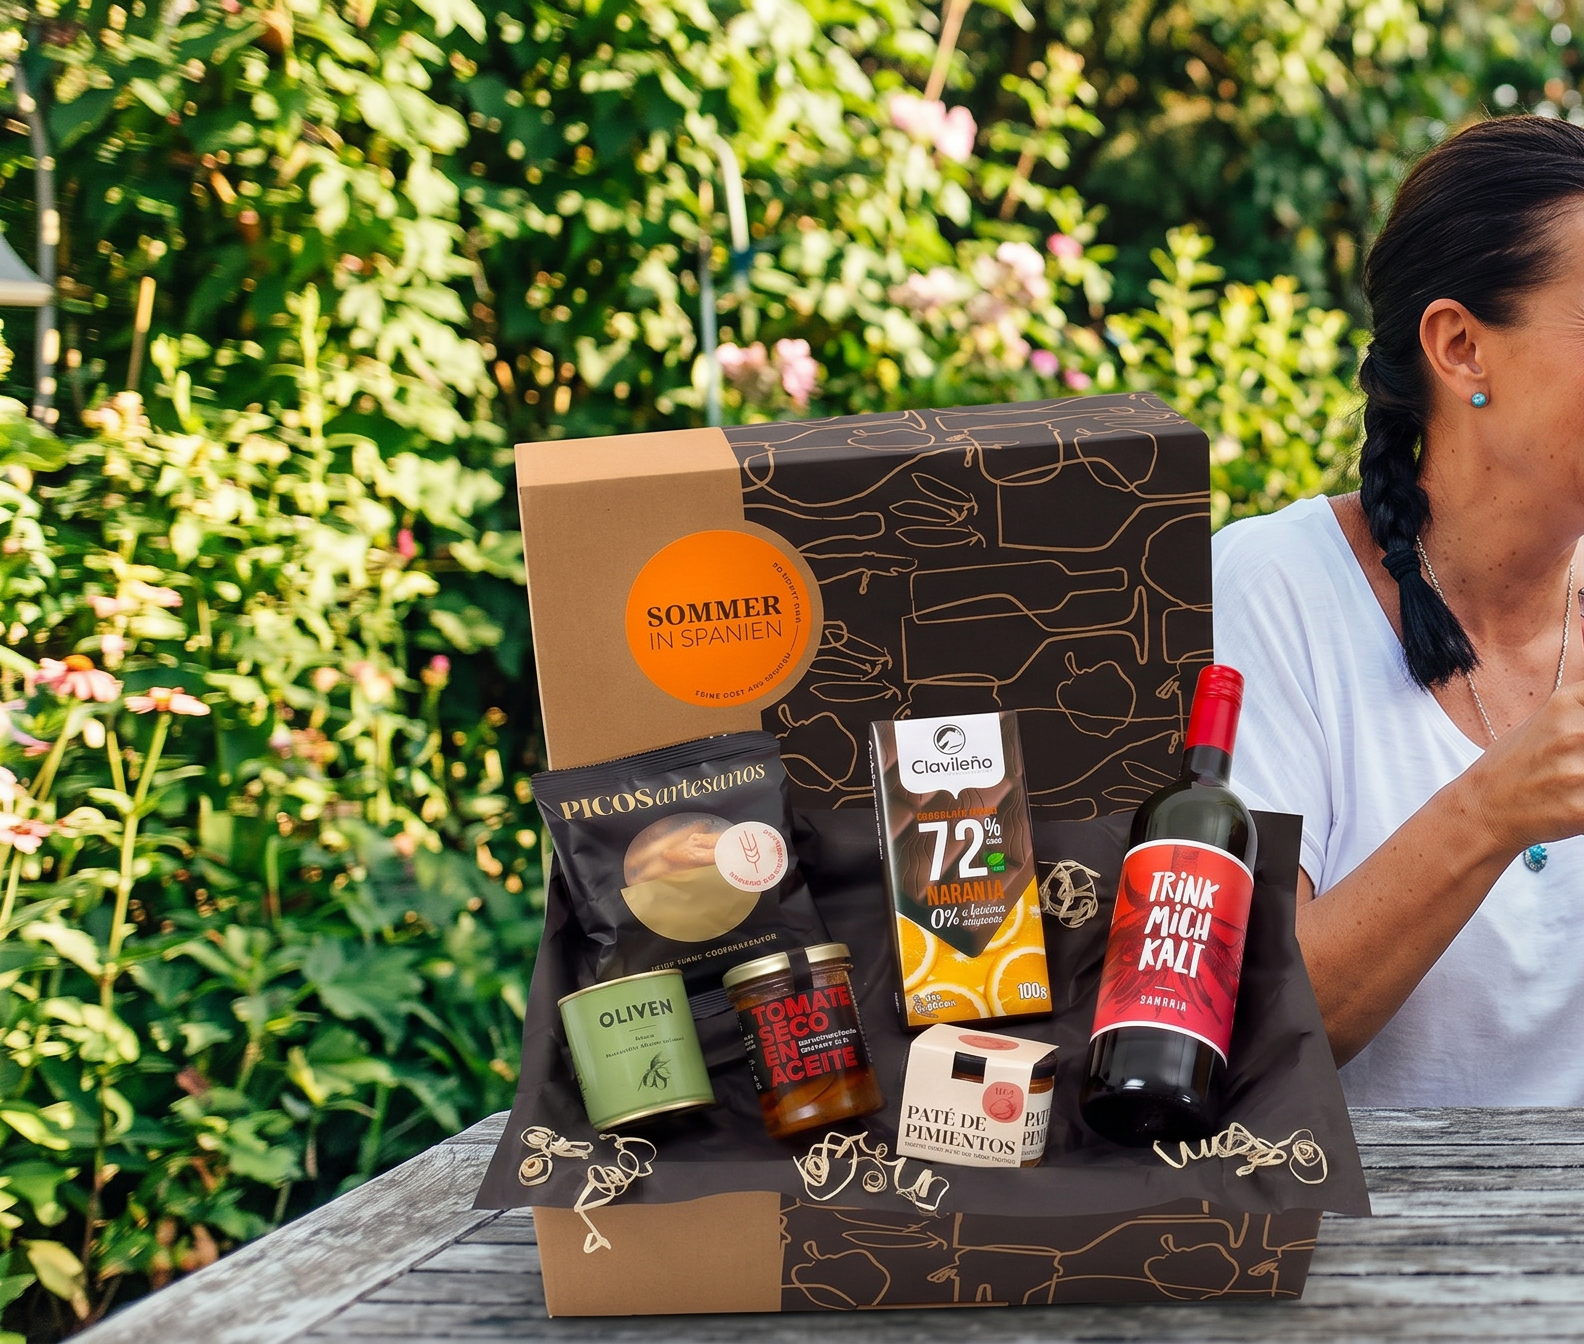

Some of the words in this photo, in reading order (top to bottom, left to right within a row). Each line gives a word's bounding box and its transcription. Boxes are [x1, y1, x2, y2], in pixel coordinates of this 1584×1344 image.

[646, 595, 782, 628] SOMMER
[650, 631, 674, 651] IN
[681, 619, 783, 648] SPANIEN
[911, 755, 993, 775] Clavileño
[1138, 937, 1206, 979] KALT
[599, 998, 674, 1029] OLIVEN
[751, 986, 851, 1027] TOMATE
[758, 1011, 829, 1047] SECO
[762, 1040, 800, 1068] EN
[771, 1046, 859, 1088] ACEITE
[907, 1104, 955, 1127] PATÉ
[960, 1113, 987, 1132] DE
[905, 1123, 1016, 1156] PIMIENTOS
